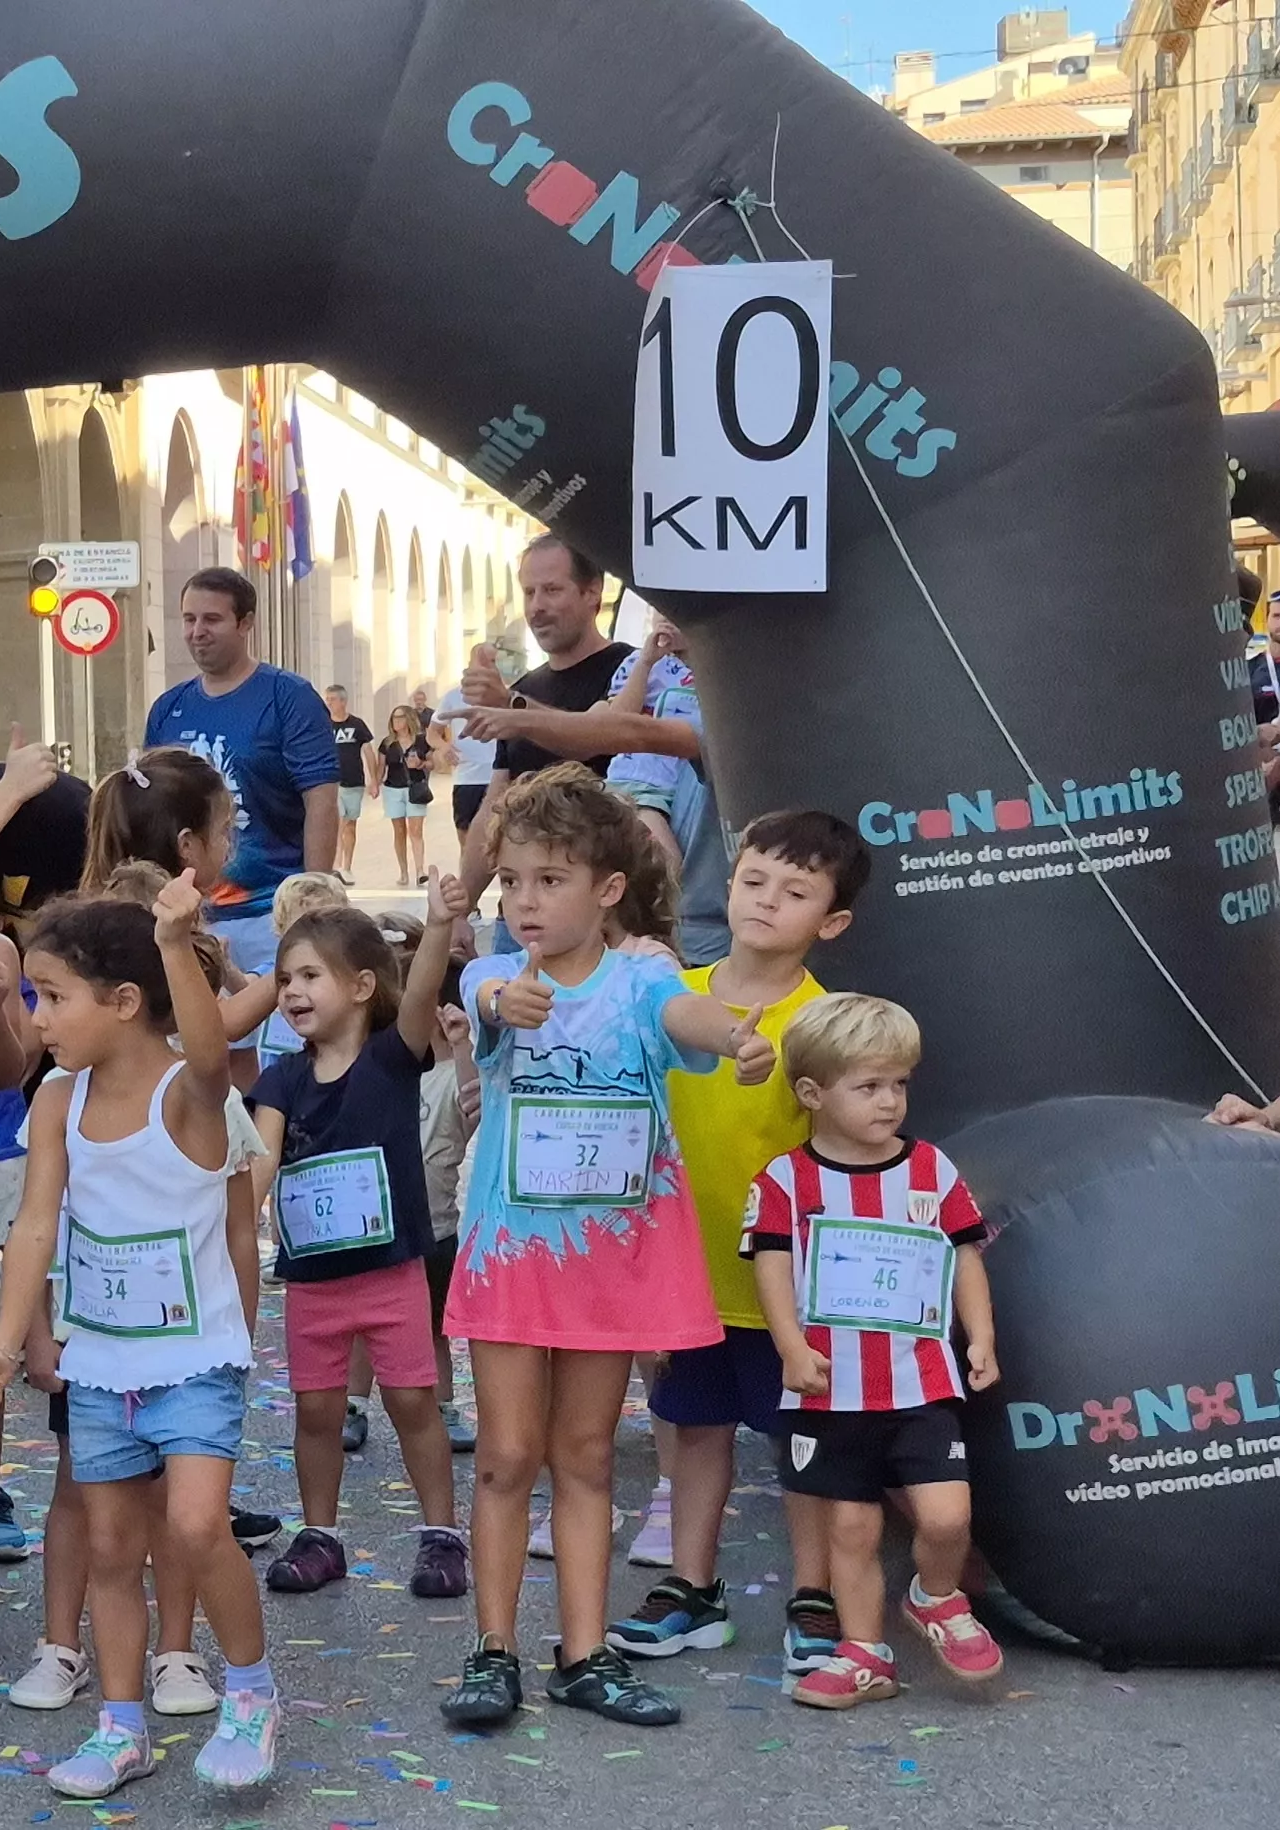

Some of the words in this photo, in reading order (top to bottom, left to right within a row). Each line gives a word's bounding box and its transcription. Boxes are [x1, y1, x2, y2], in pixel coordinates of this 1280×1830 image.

[642, 295, 821, 463] 10
[643, 491, 809, 552] KM
[899, 852, 973, 872] Servicio
[977, 845, 1003, 863] de
[1137, 826, 1150, 843] y
[894, 871, 964, 897] gestión
[968, 869, 995, 887] de
[998, 860, 1074, 884] eventos
[575, 1144, 600, 1167] 32
[314, 1195, 334, 1217] 62
[103, 1278, 128, 1301] 34
[873, 1267, 898, 1291] 46
[1108, 1446, 1199, 1475] Servicio
[1202, 1439, 1234, 1462] de
[1064, 1481, 1131, 1504] vídeo
